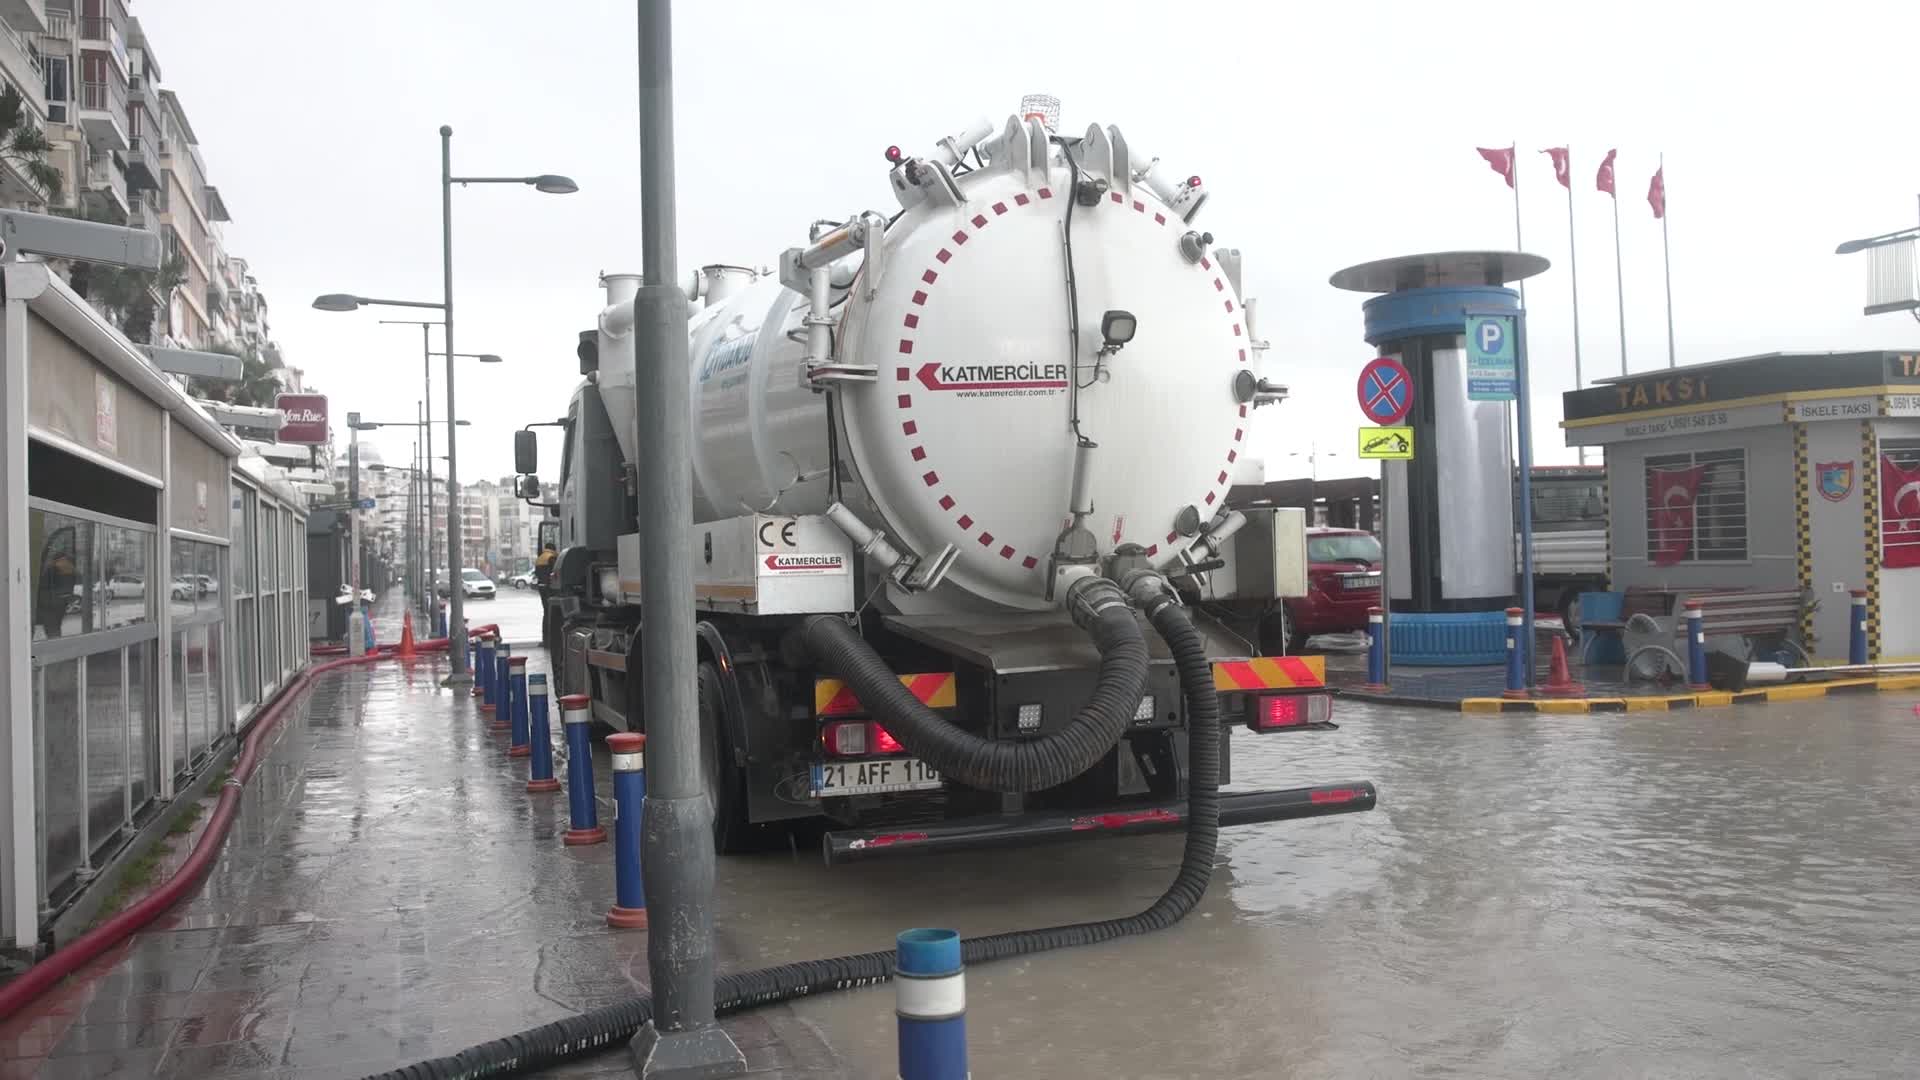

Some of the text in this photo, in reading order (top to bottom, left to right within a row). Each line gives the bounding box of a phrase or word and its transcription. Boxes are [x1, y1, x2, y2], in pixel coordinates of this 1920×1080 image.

[1482, 324, 1500, 352] P
[942, 361, 1067, 382] KATMERCİLER
[1840, 401, 1872, 415] TAKSİ
[759, 521, 796, 547] CE
[778, 556, 842, 566] KATMERCİLER
[824, 765, 845, 788] 21
[857, 762, 891, 785] AFF
